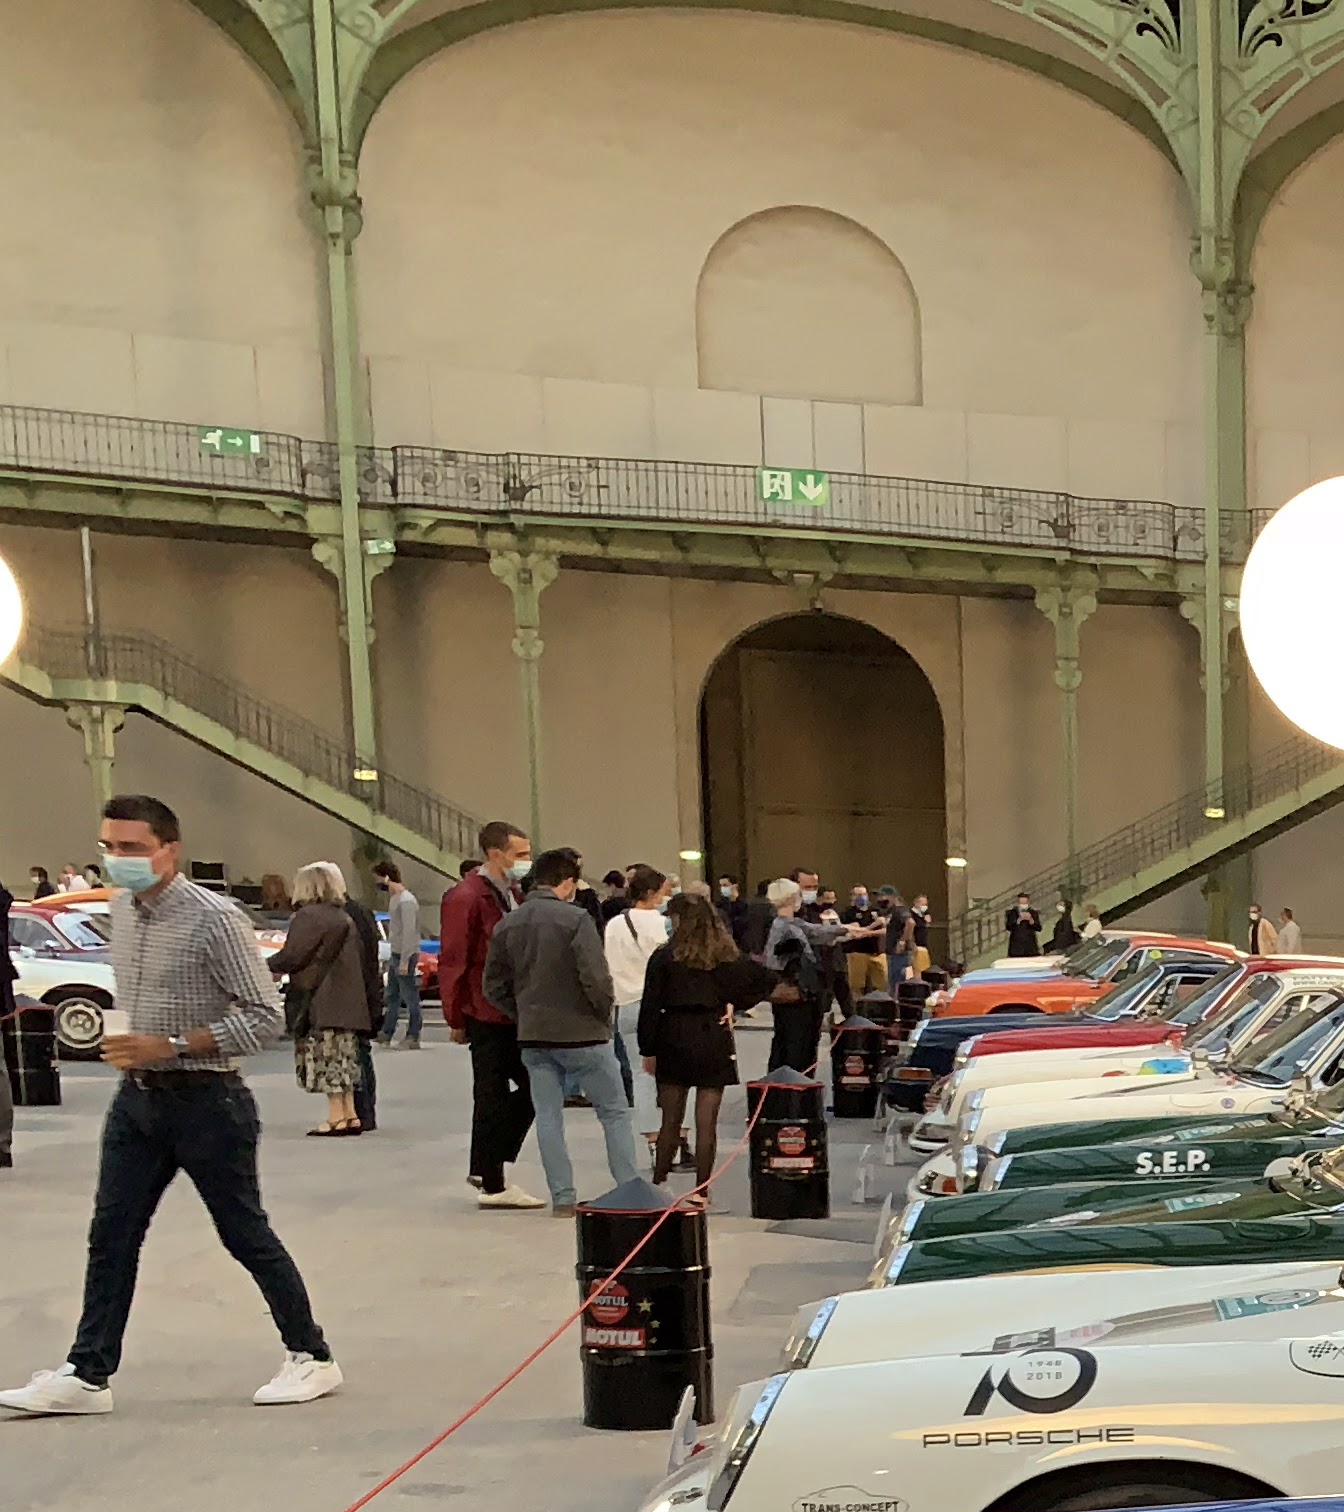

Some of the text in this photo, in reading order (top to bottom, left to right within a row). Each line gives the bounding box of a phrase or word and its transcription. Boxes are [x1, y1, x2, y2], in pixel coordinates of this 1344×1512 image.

[1135, 1150, 1211, 1174] S.E.P.
[585, 1328, 642, 1346] MOTUL
[923, 1427, 1135, 1449] PORSCHE
